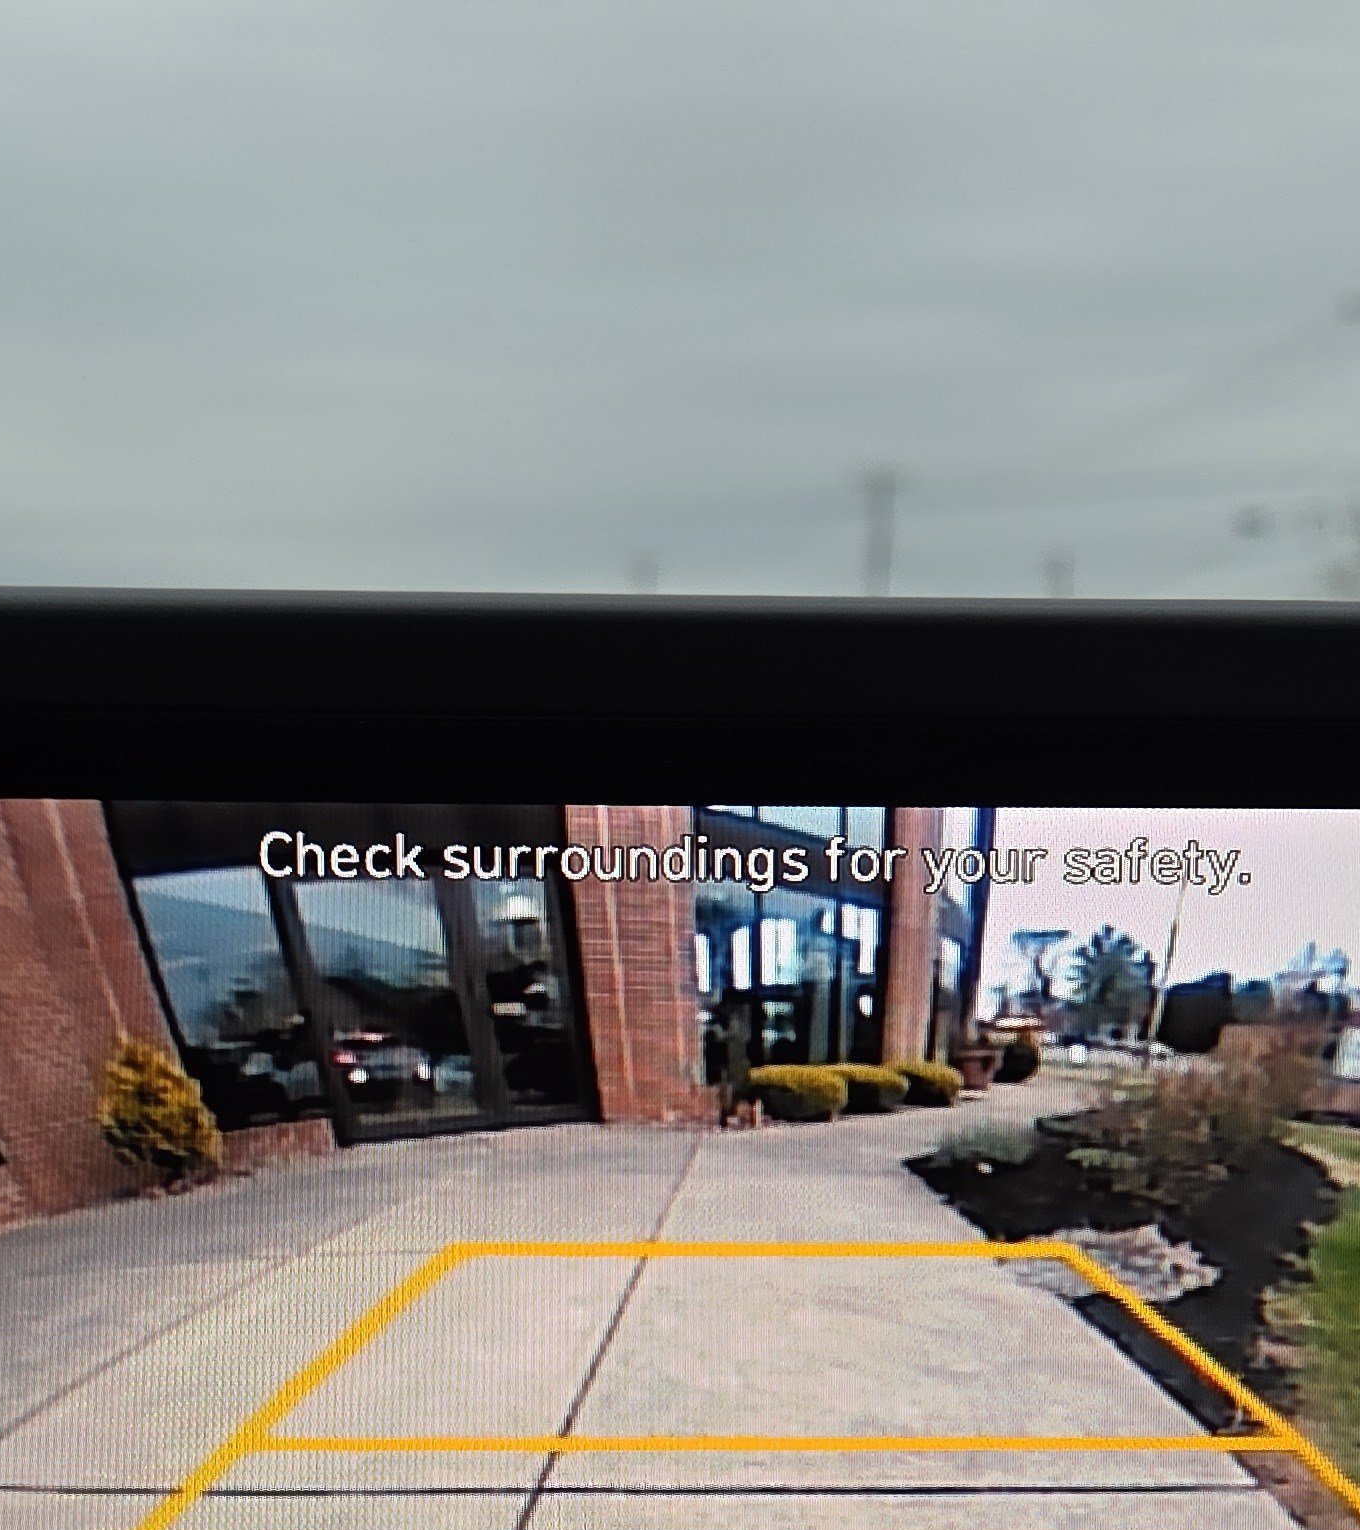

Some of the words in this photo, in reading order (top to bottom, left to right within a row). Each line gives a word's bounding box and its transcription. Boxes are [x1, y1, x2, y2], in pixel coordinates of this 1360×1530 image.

[258, 830, 428, 879] Check
[442, 834, 810, 893] surroundings
[824, 836, 908, 883] for
[921, 844, 1047, 895] your
[1062, 836, 1254, 896] safety.
